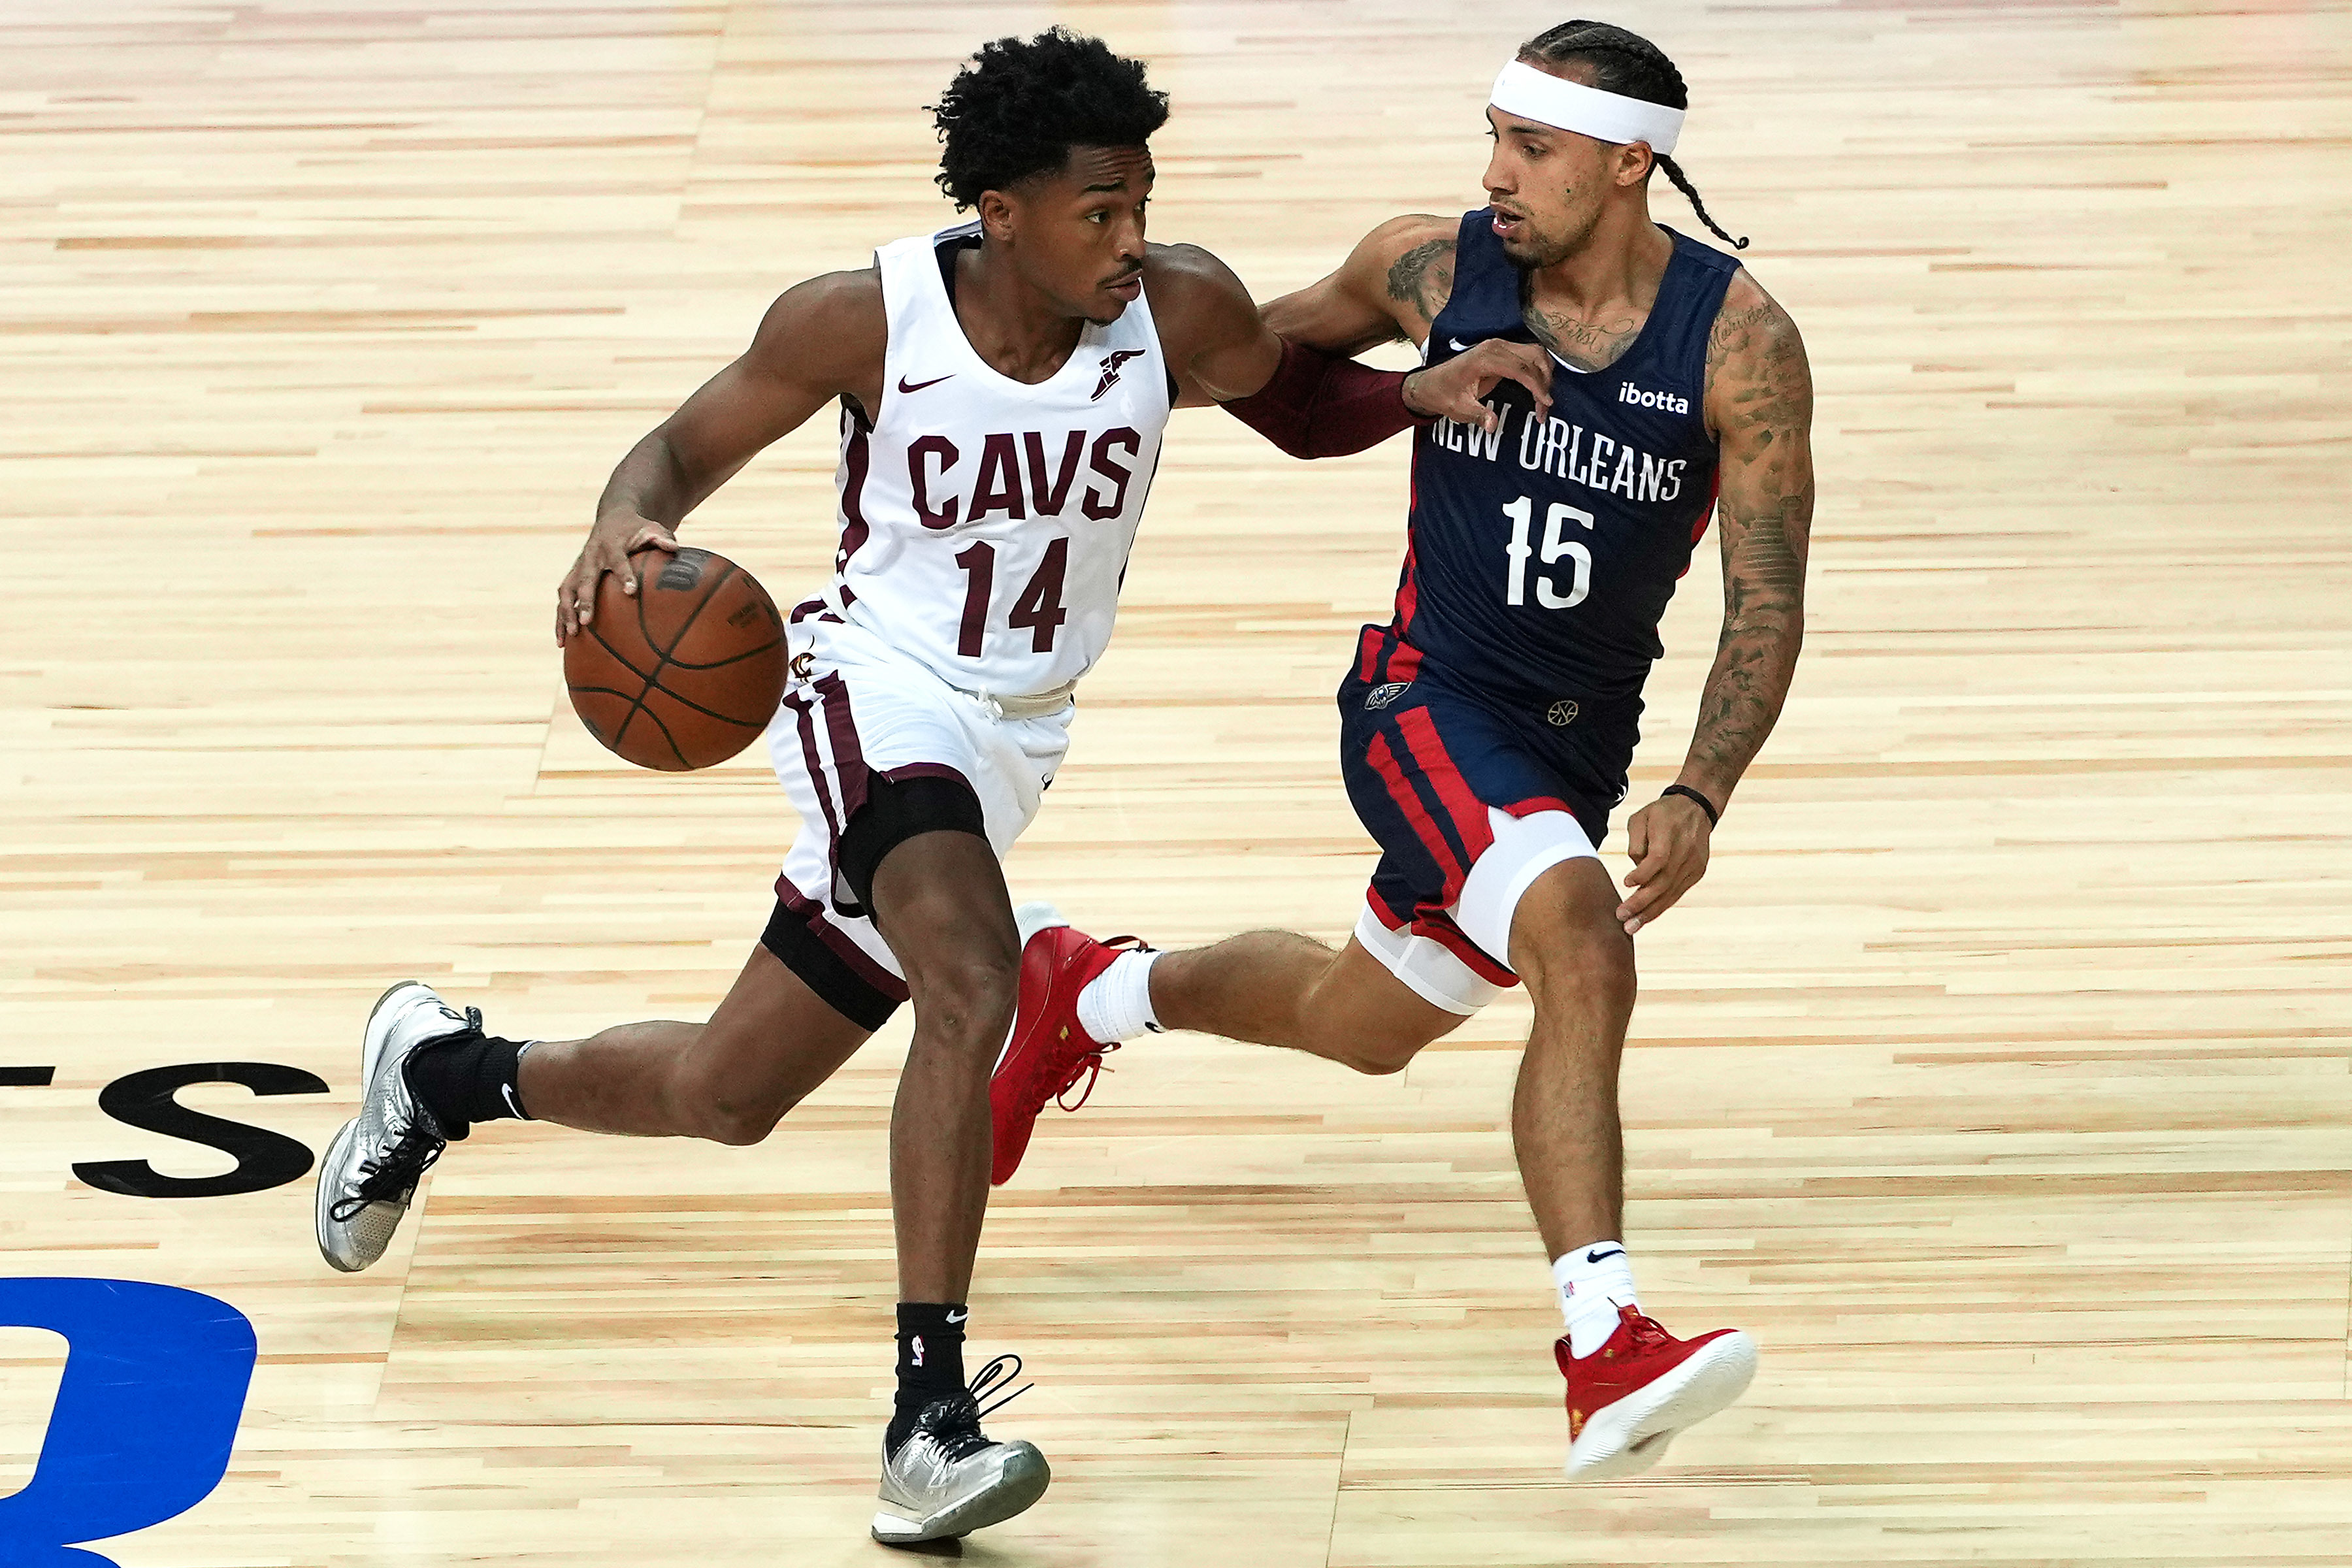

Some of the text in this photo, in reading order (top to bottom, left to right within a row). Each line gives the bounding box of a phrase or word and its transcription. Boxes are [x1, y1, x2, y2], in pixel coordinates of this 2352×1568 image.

[1618, 381, 1689, 415] ibotta
[907, 426, 1141, 531] CAVS
[1519, 411, 1688, 502] ORLEANS
[955, 536, 1070, 658] 14
[1502, 495, 1595, 610] 15
